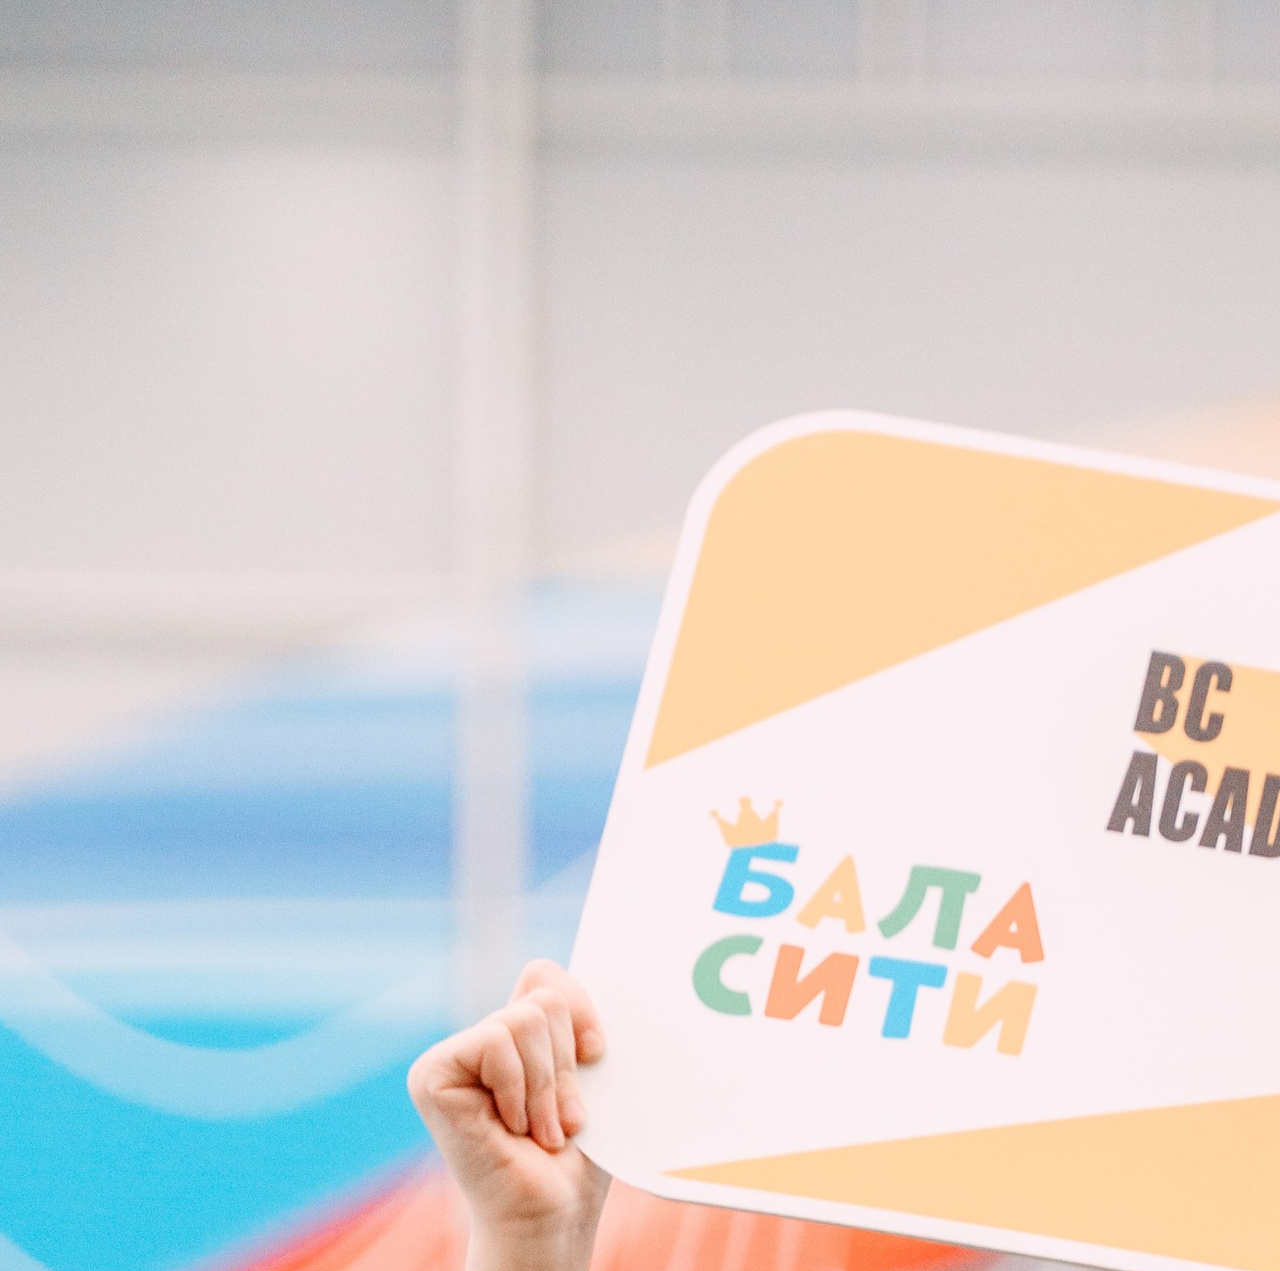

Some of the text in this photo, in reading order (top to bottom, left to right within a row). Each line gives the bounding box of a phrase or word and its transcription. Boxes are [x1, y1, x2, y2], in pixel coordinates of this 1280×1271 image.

[1134, 650, 1233, 742] BC
[712, 842, 1045, 963] БАЛА
[692, 934, 1038, 1056] СИТИ
